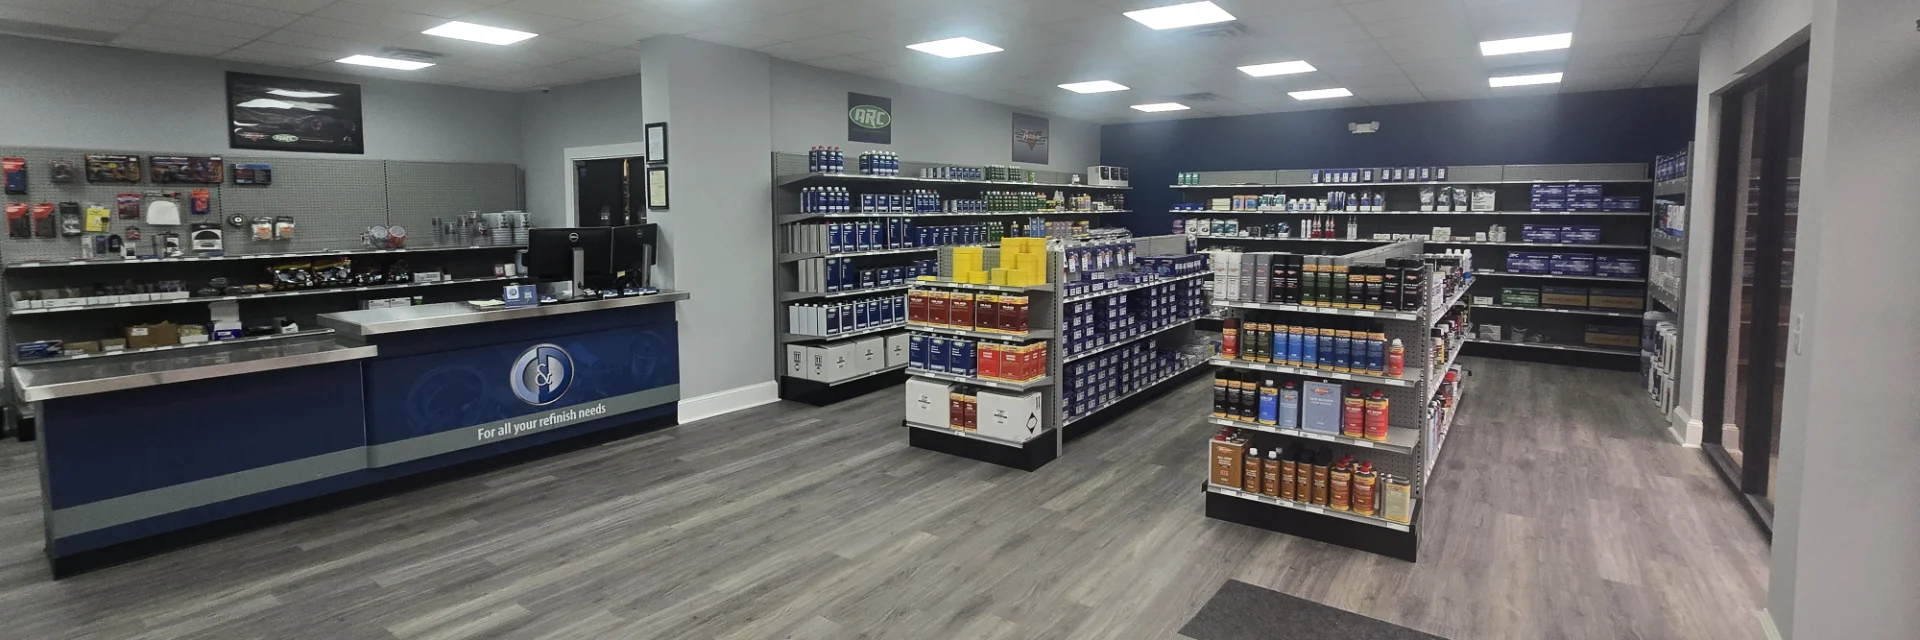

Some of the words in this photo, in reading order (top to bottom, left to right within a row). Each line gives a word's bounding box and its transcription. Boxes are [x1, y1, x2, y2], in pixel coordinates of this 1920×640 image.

[855, 108, 886, 128] ARC
[478, 428, 496, 440] For
[497, 422, 512, 436] all
[513, 420, 537, 435] your
[539, 410, 577, 426] refinish
[578, 403, 606, 418] needs
